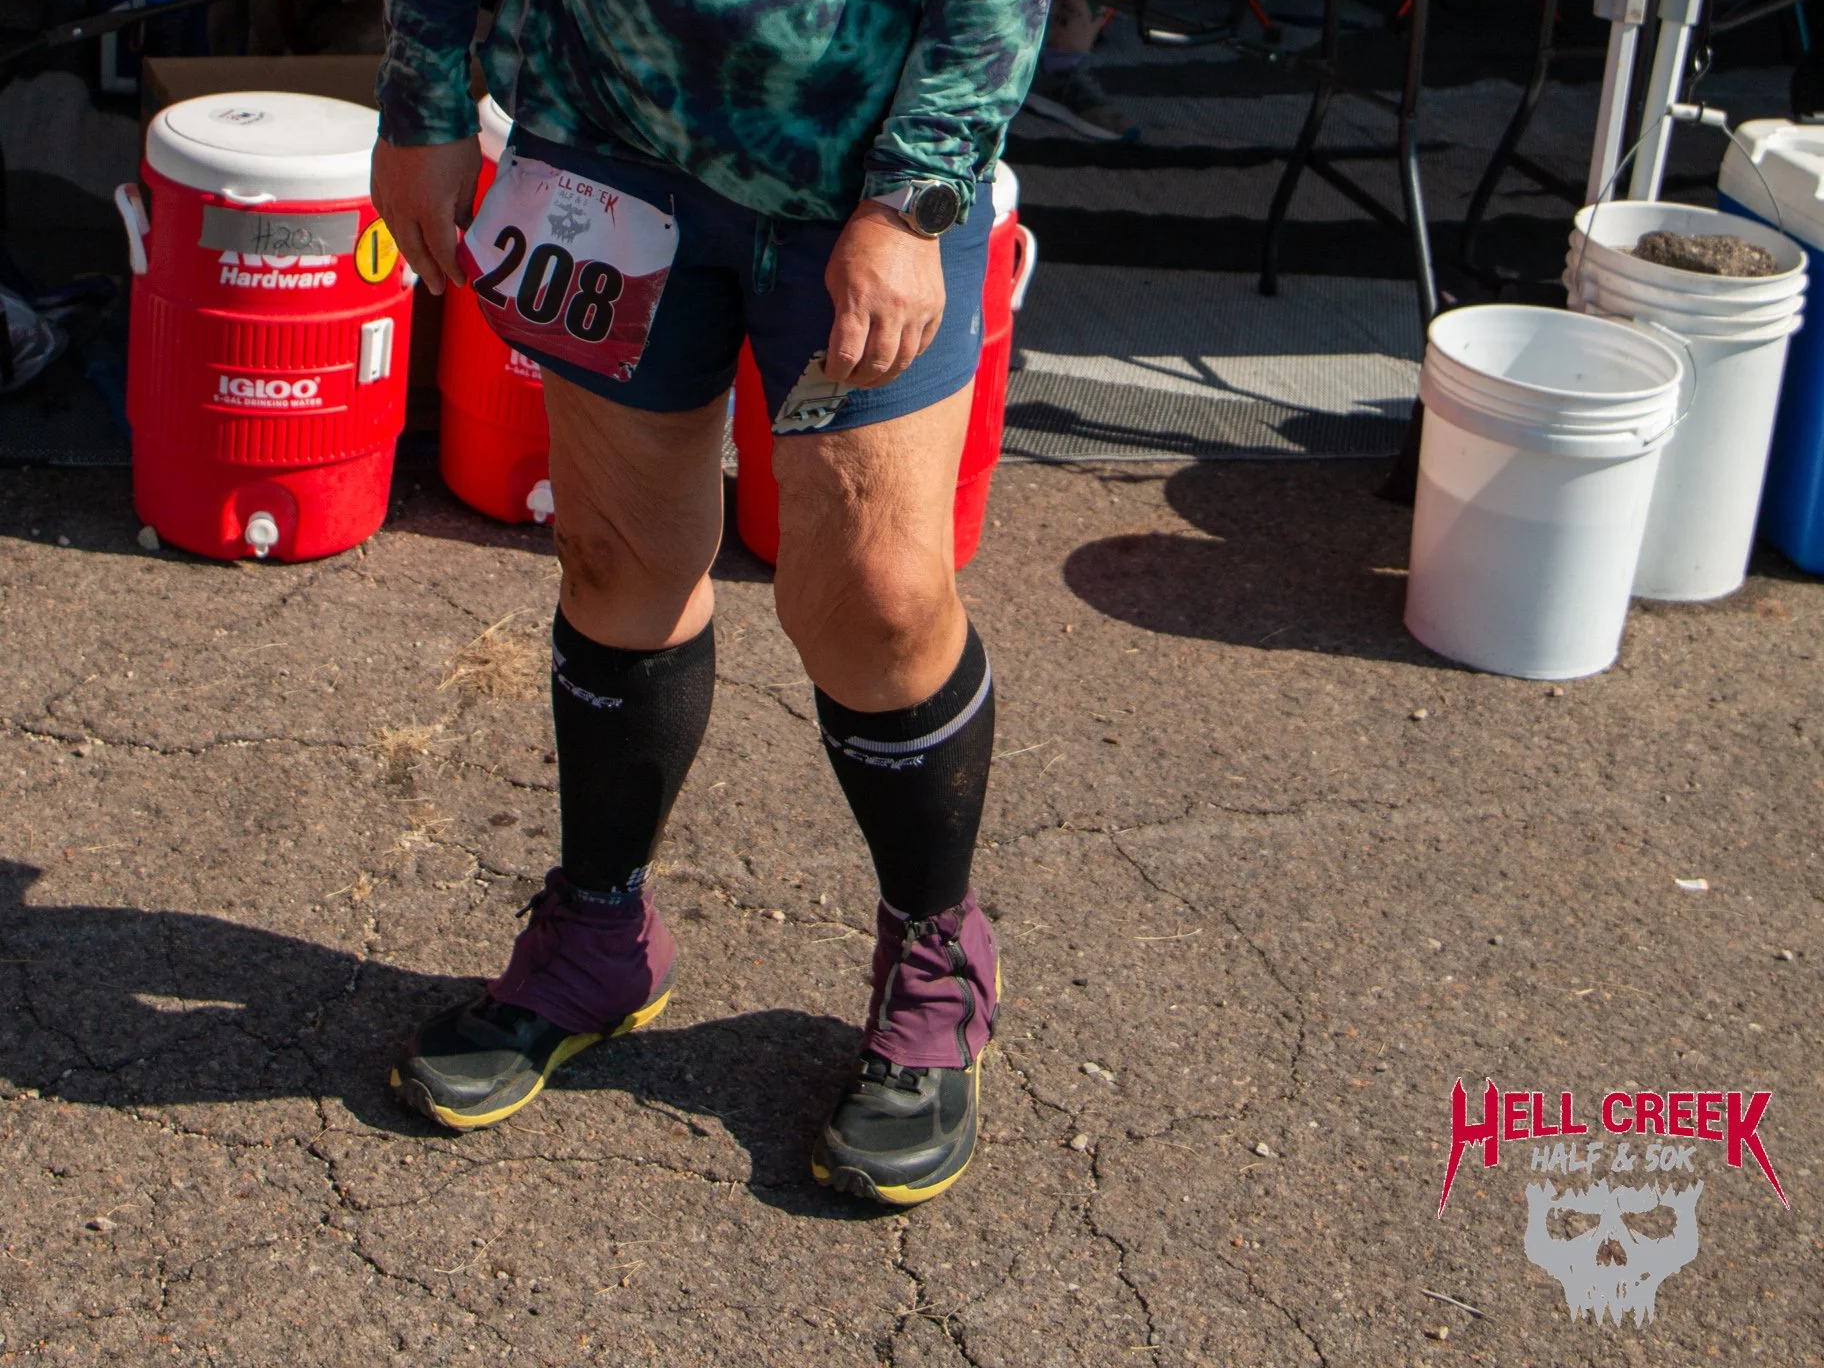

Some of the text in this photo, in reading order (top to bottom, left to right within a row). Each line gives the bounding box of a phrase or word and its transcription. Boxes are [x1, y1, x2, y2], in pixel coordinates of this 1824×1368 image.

[219, 266, 337, 290] Hardware
[473, 224, 625, 343] 208
[219, 375, 318, 399] IGLOO
[244, 398, 289, 409] DRINKING
[290, 398, 323, 409] WATER
